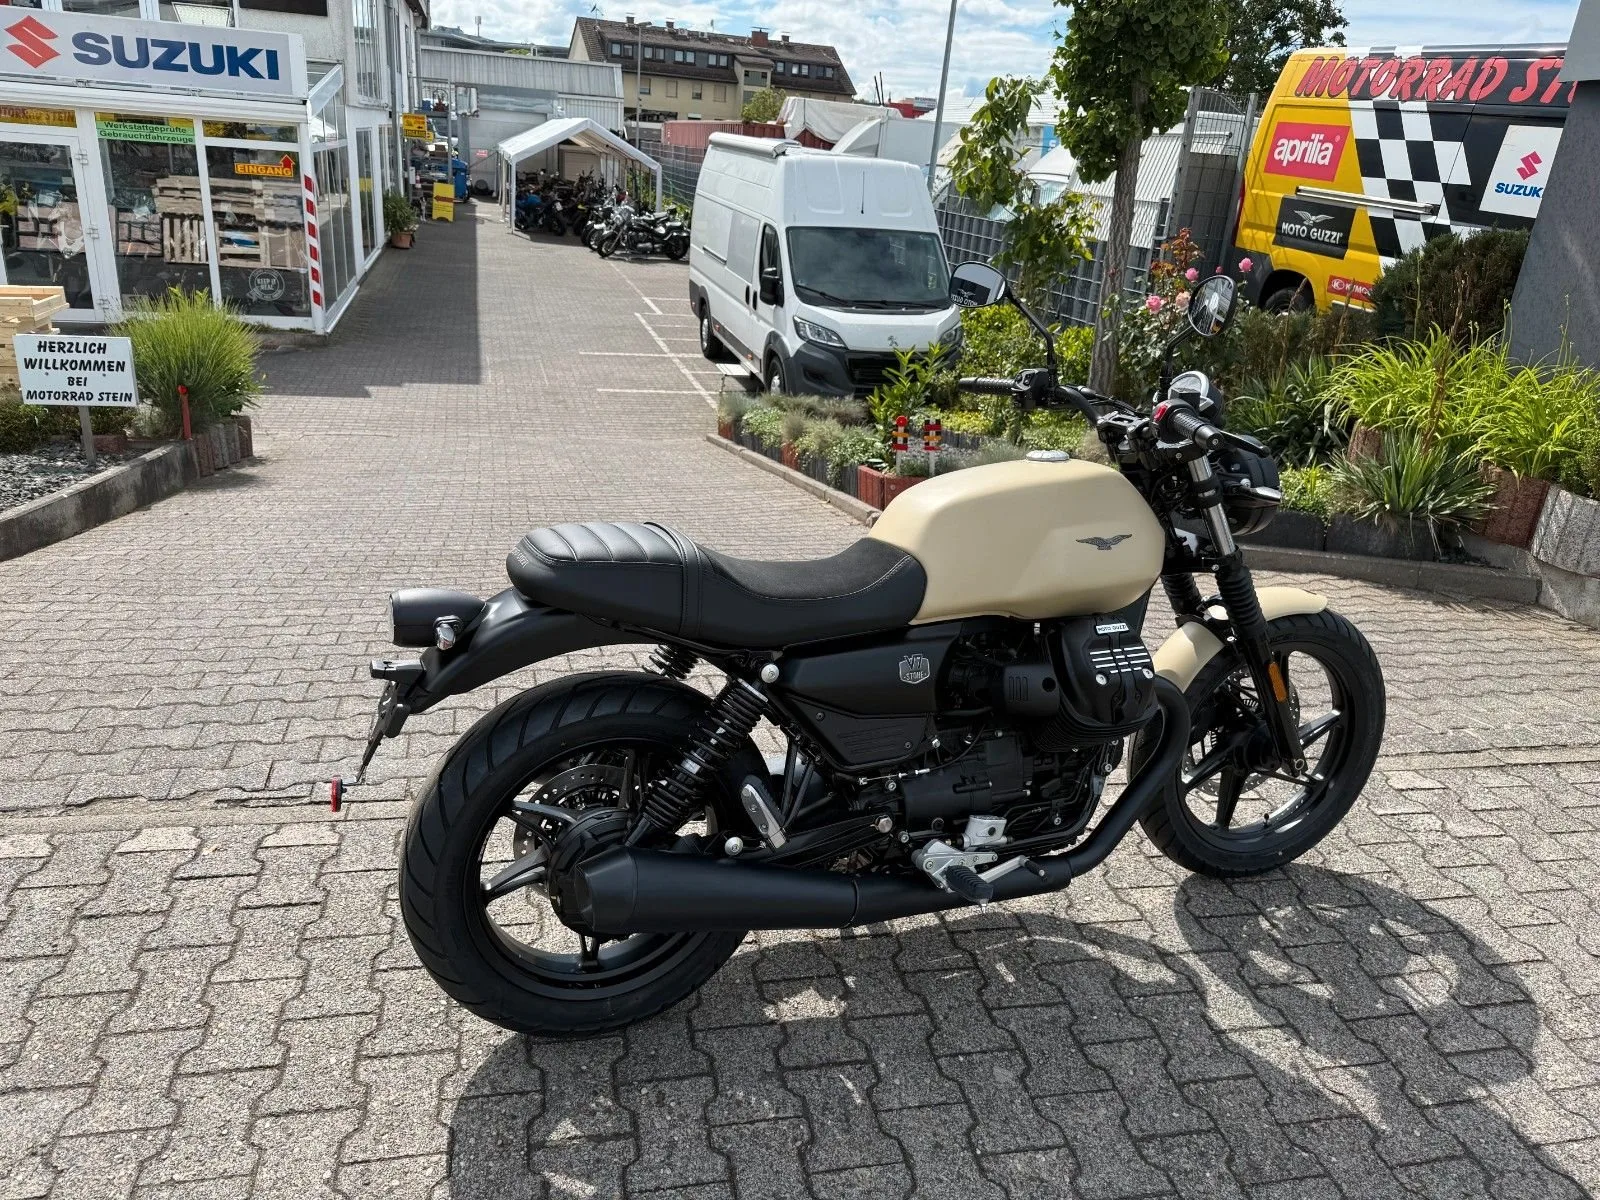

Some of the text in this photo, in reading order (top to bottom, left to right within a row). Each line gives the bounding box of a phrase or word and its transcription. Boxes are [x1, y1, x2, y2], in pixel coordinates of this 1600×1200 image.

[71, 31, 280, 81] SUZUKI
[1295, 56, 1578, 104] MOTORRAD ST
[99, 130, 194, 144] Gebrauchtfahrzeuge
[1273, 133, 1333, 167] aprilia
[237, 164, 292, 176] EINGANG
[1494, 182, 1544, 198] SUZUK
[1281, 221, 1341, 245] MOTO GUZZI
[37, 340, 107, 354] HERZLICH
[23, 357, 126, 373] WILLKOMMEN
[67, 376, 88, 387] BEI
[26, 390, 133, 402] MOTORRAD STEIN
